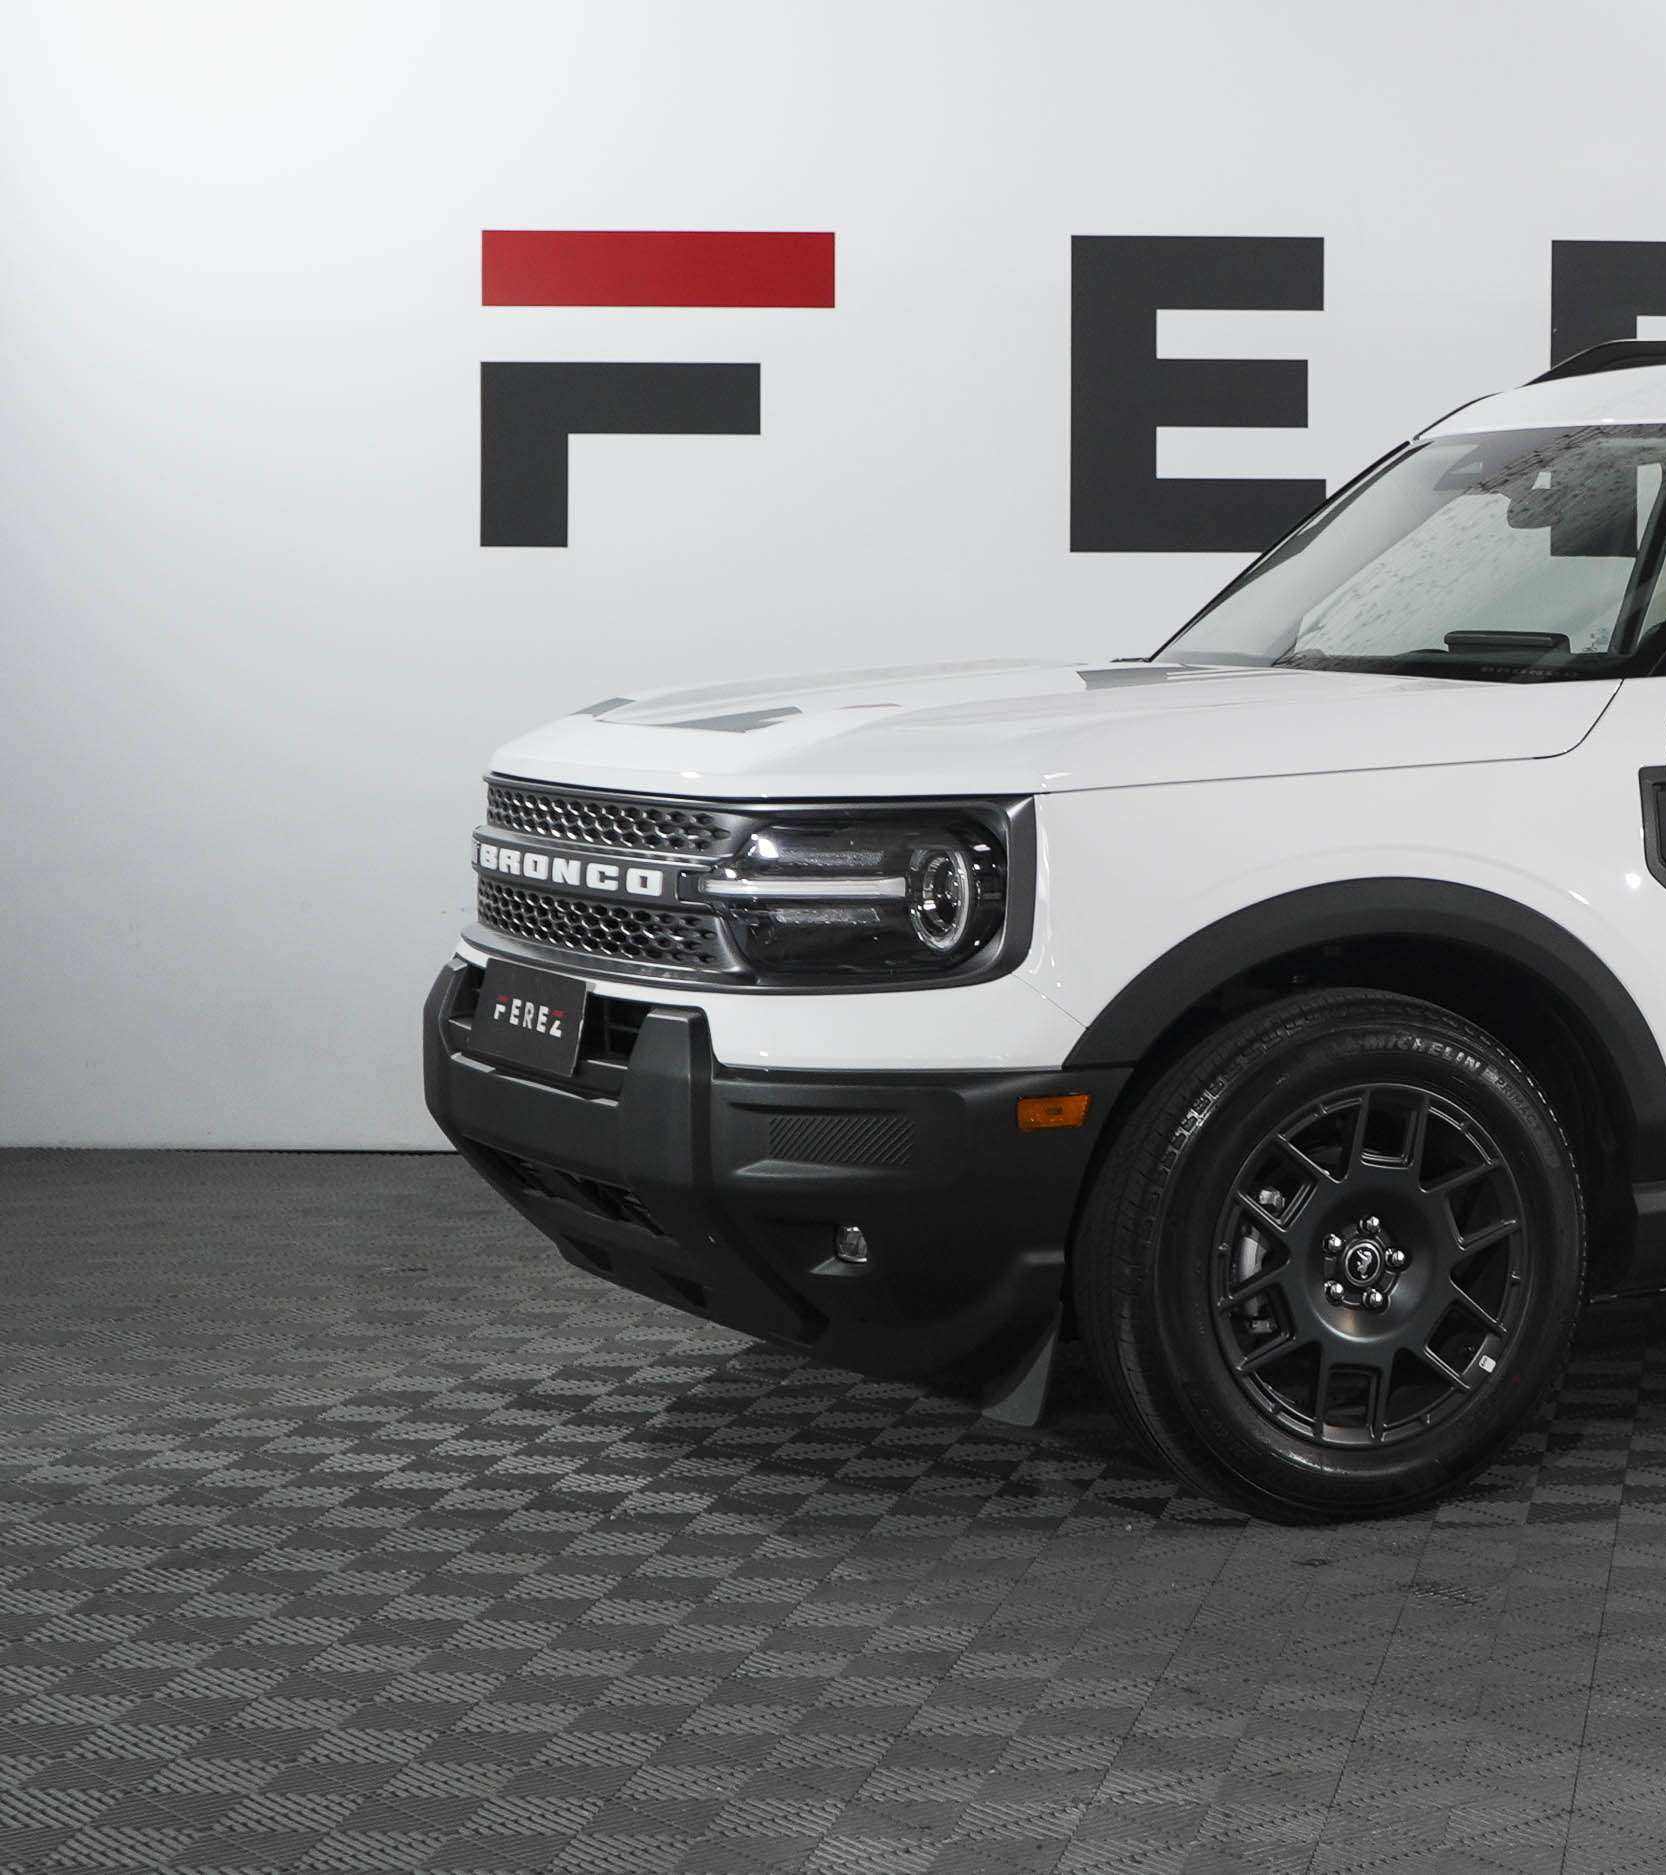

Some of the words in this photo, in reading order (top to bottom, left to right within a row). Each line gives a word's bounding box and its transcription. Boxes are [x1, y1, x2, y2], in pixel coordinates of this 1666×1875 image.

[480, 843, 663, 896] BRONCO
[493, 994, 567, 1038] FEREZ
[1362, 1034, 1481, 1071] MICHELIN
